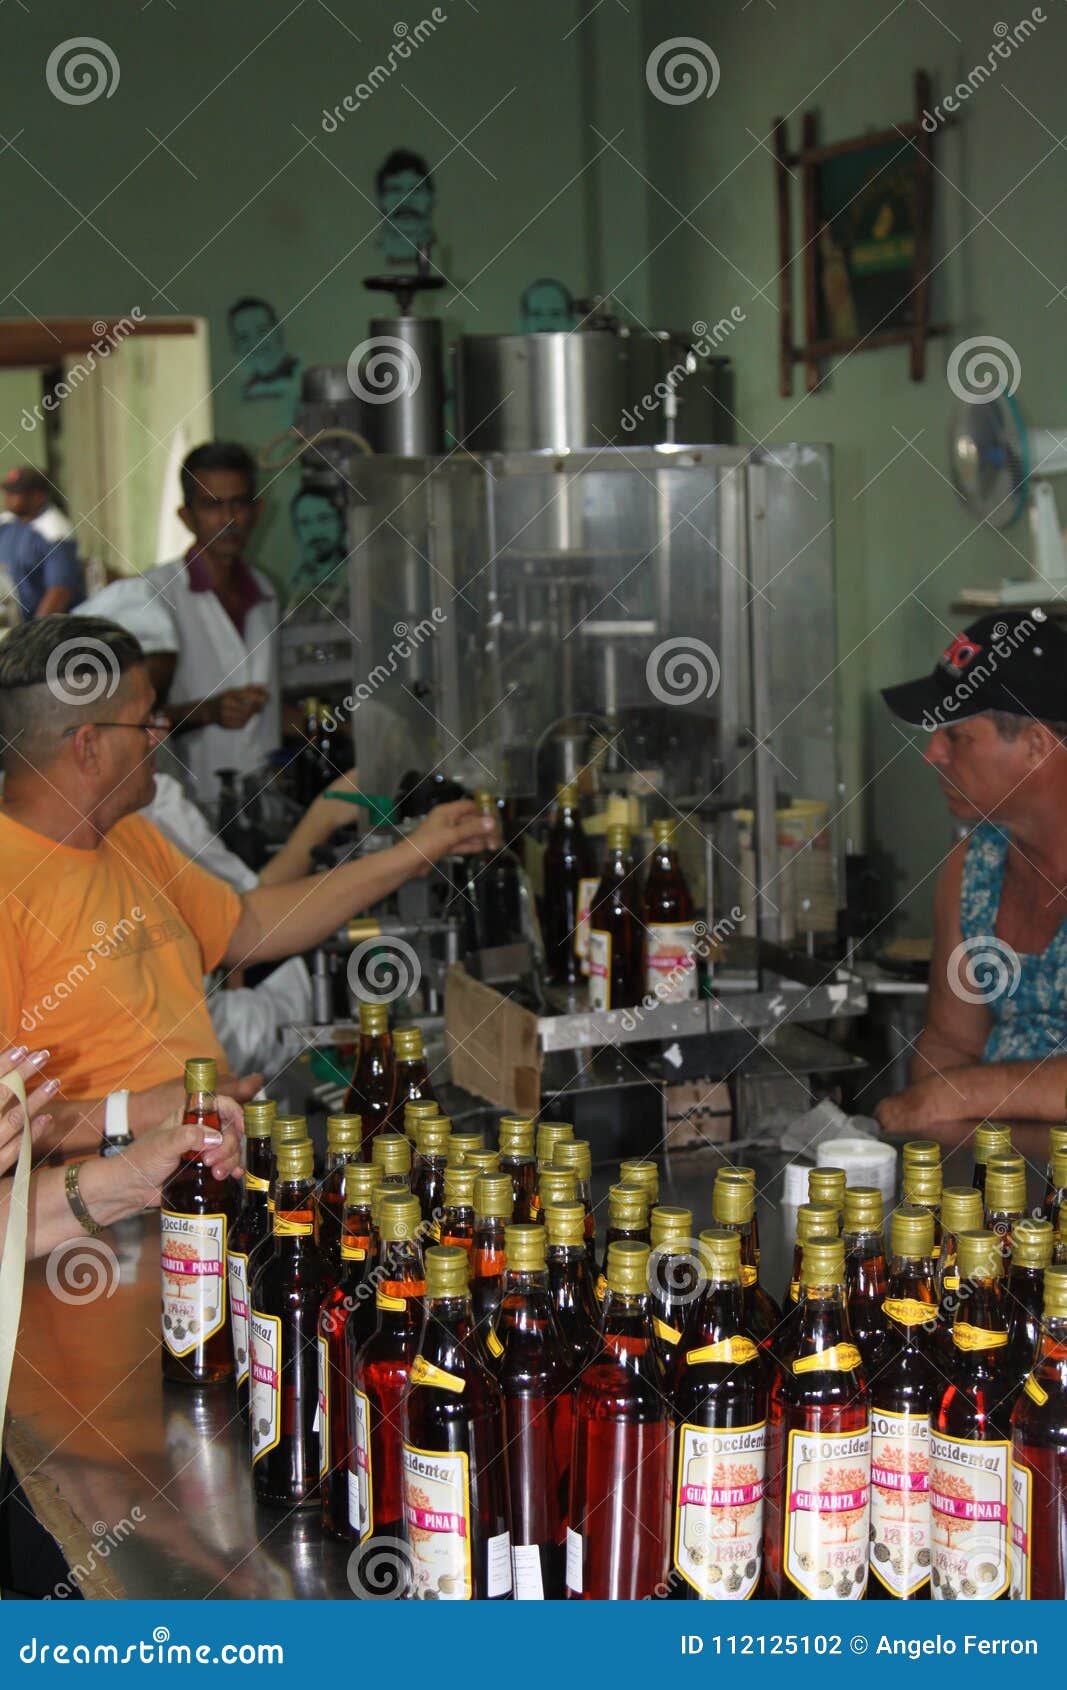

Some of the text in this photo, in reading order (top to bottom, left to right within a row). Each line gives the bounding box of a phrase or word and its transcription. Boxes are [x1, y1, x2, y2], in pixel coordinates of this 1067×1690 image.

[192, 1262, 219, 1274] PINAR
[877, 1418, 928, 1438] Occde
[820, 1438, 869, 1458] Occiden
[930, 1439, 1000, 1471] Occidental
[872, 1468, 913, 1489] AYABITA
[796, 1493, 854, 1509] GUAYABITA
[965, 1504, 1001, 1519] PINAR
[424, 1513, 459, 1530] PINAR
